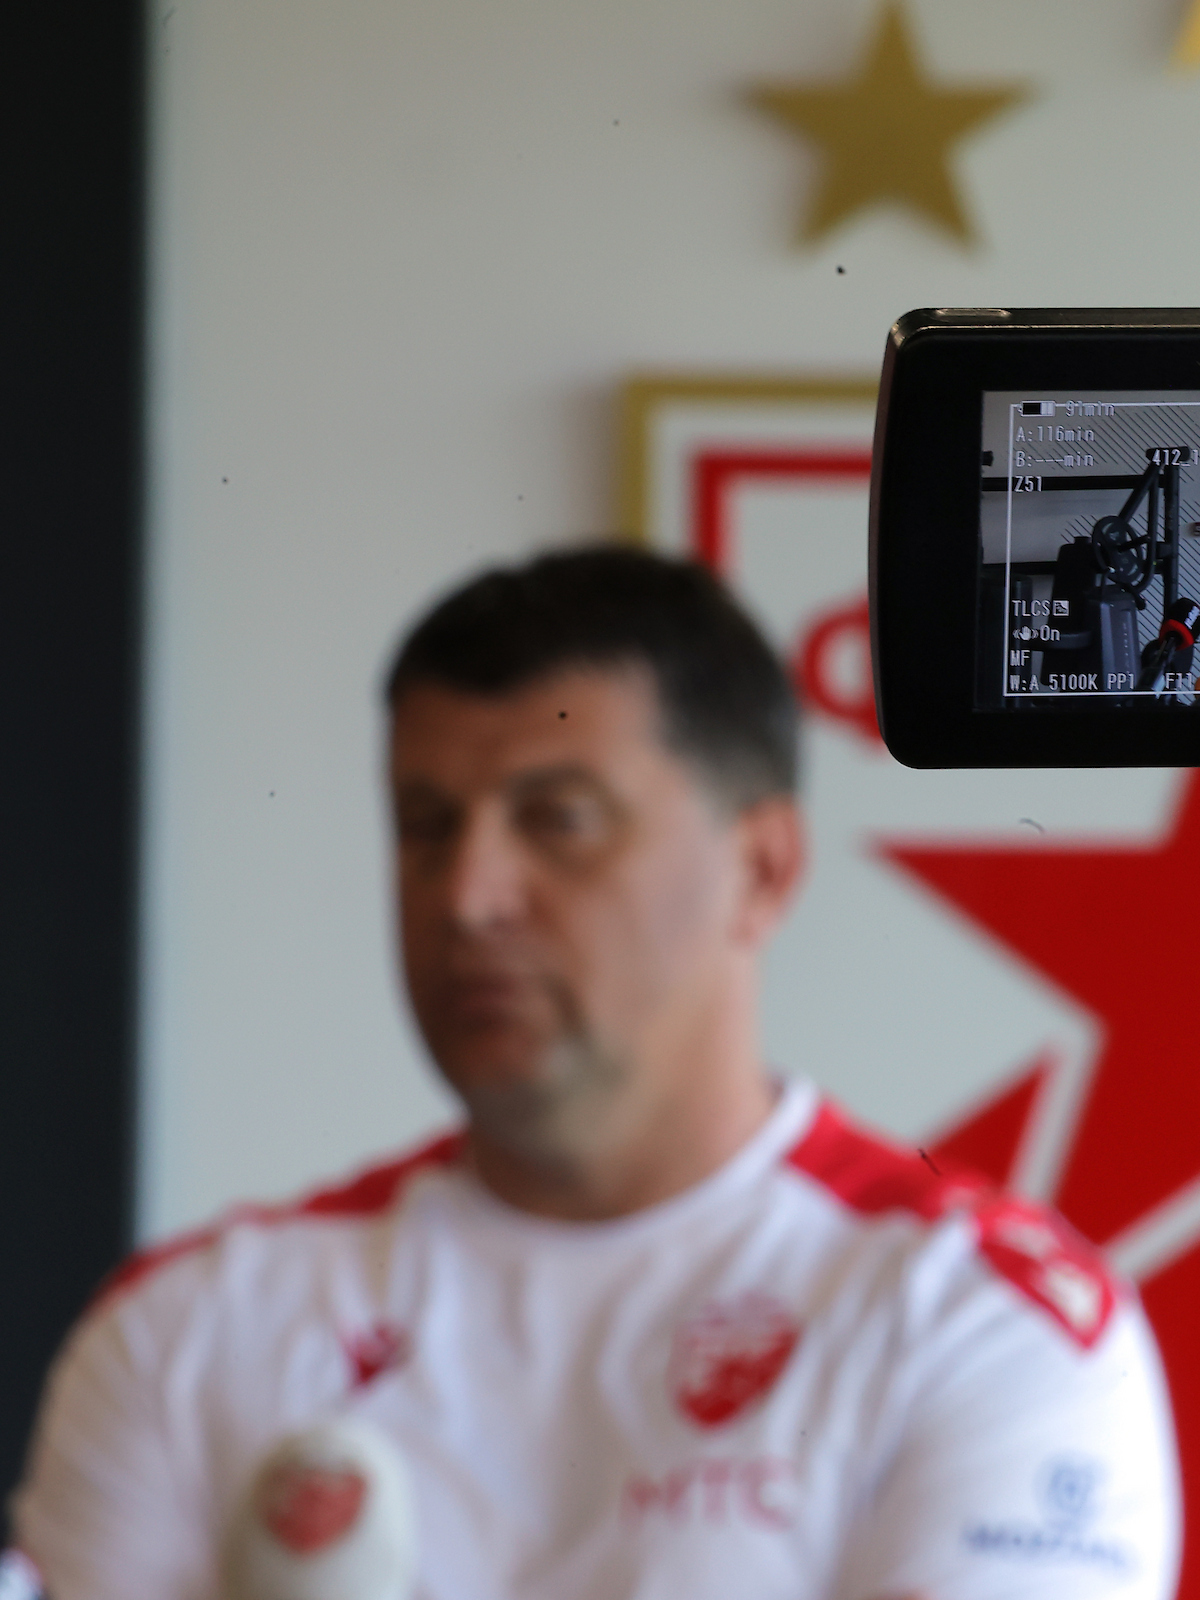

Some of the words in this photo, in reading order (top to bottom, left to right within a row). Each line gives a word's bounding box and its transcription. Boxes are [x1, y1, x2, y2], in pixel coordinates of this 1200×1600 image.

[1015, 426, 1095, 442] A:116min
[1014, 475, 1043, 492] Z51
[1011, 600, 1051, 617] TLCS
[1039, 625, 1060, 641] On
[1010, 650, 1031, 667] MF
[1009, 674, 1039, 691] W:A
[1049, 673, 1098, 690] 5100K
[1107, 673, 1135, 690] PP1
